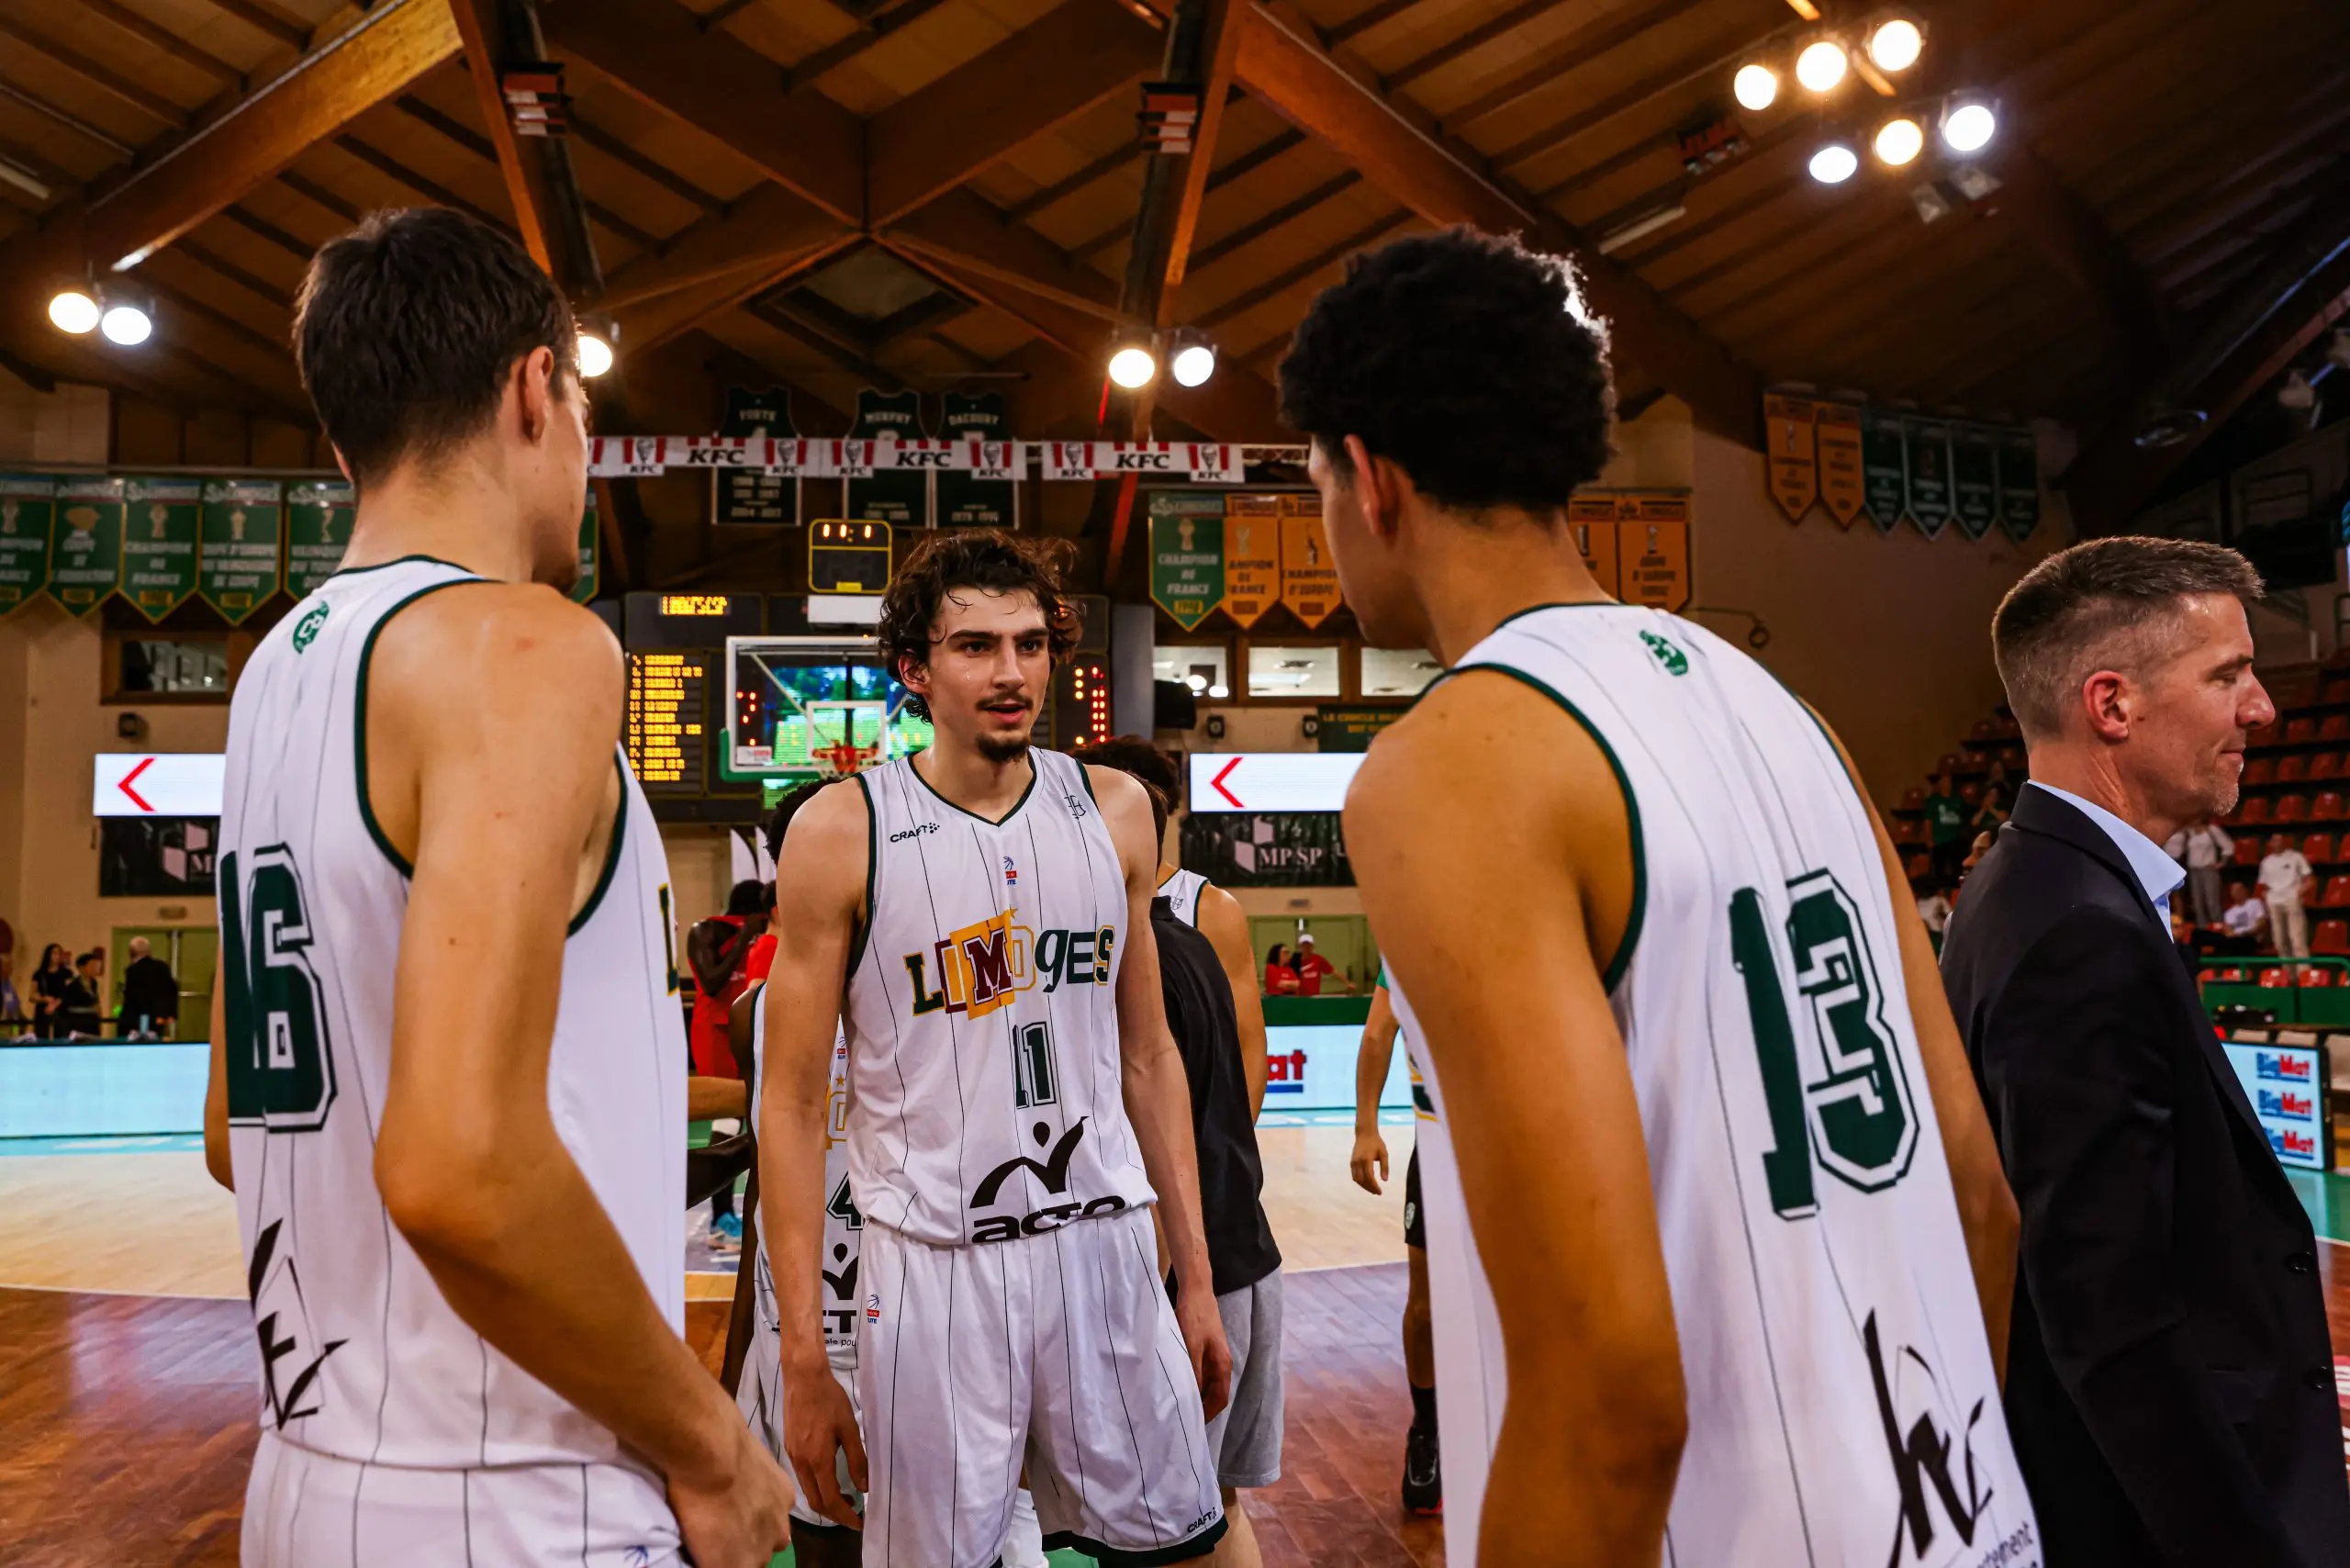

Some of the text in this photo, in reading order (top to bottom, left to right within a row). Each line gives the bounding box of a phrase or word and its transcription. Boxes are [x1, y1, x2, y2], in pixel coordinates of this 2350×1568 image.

[688, 449, 745, 465] KFC
[896, 452, 952, 467] KFC
[1116, 454, 1170, 469] KFC
[1061, 469, 1086, 478] KFC
[1197, 471, 1223, 479] KFC
[889, 824, 930, 844] CRAFT
[1729, 867, 1920, 1222] 13
[1187, 1511, 1213, 1533] CRAFT
